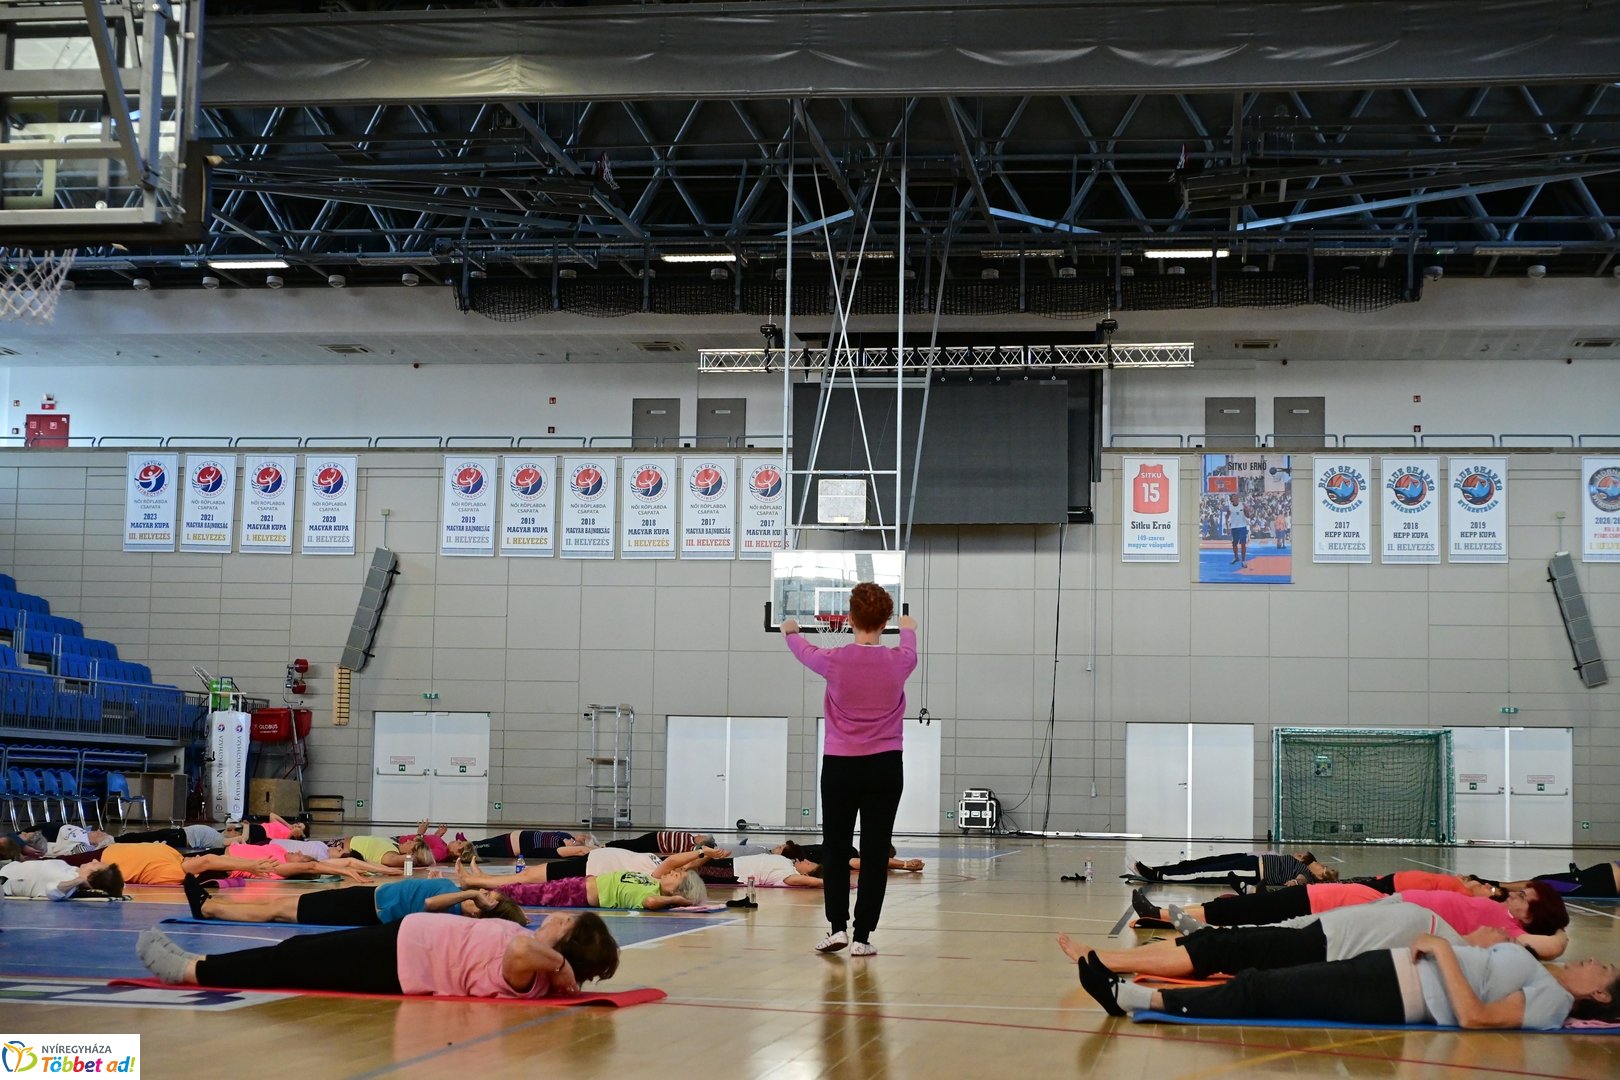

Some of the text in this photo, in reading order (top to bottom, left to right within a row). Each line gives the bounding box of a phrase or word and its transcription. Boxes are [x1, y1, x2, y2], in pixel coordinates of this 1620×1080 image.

[1228, 460, 1267, 471] SITKU ERNŐ
[1318, 466, 1366, 491] BLUE SHARKS
[1386, 466, 1435, 491] BLUE SHARKS
[1454, 466, 1502, 491] BLUE SHARKS
[1142, 483, 1160, 502] 15
[1131, 520, 1171, 529] Sitku Ernő
[139, 531, 171, 540] HELYEZÉS
[192, 532, 226, 540] HELYEZÉS
[253, 533, 286, 541] HELYEZÉS
[455, 535, 489, 543] HELYEZÉS
[513, 536, 547, 544] HELYEZÉS
[575, 537, 610, 545] HELYEZÉS
[635, 538, 669, 547] HELYEZÉS
[697, 537, 730, 546] HELYEZÉS
[1328, 541, 1366, 550] HELYEZÉS
[1464, 541, 1502, 550] HELYEZÉS
[1397, 542, 1435, 551] HELYEZÉS
